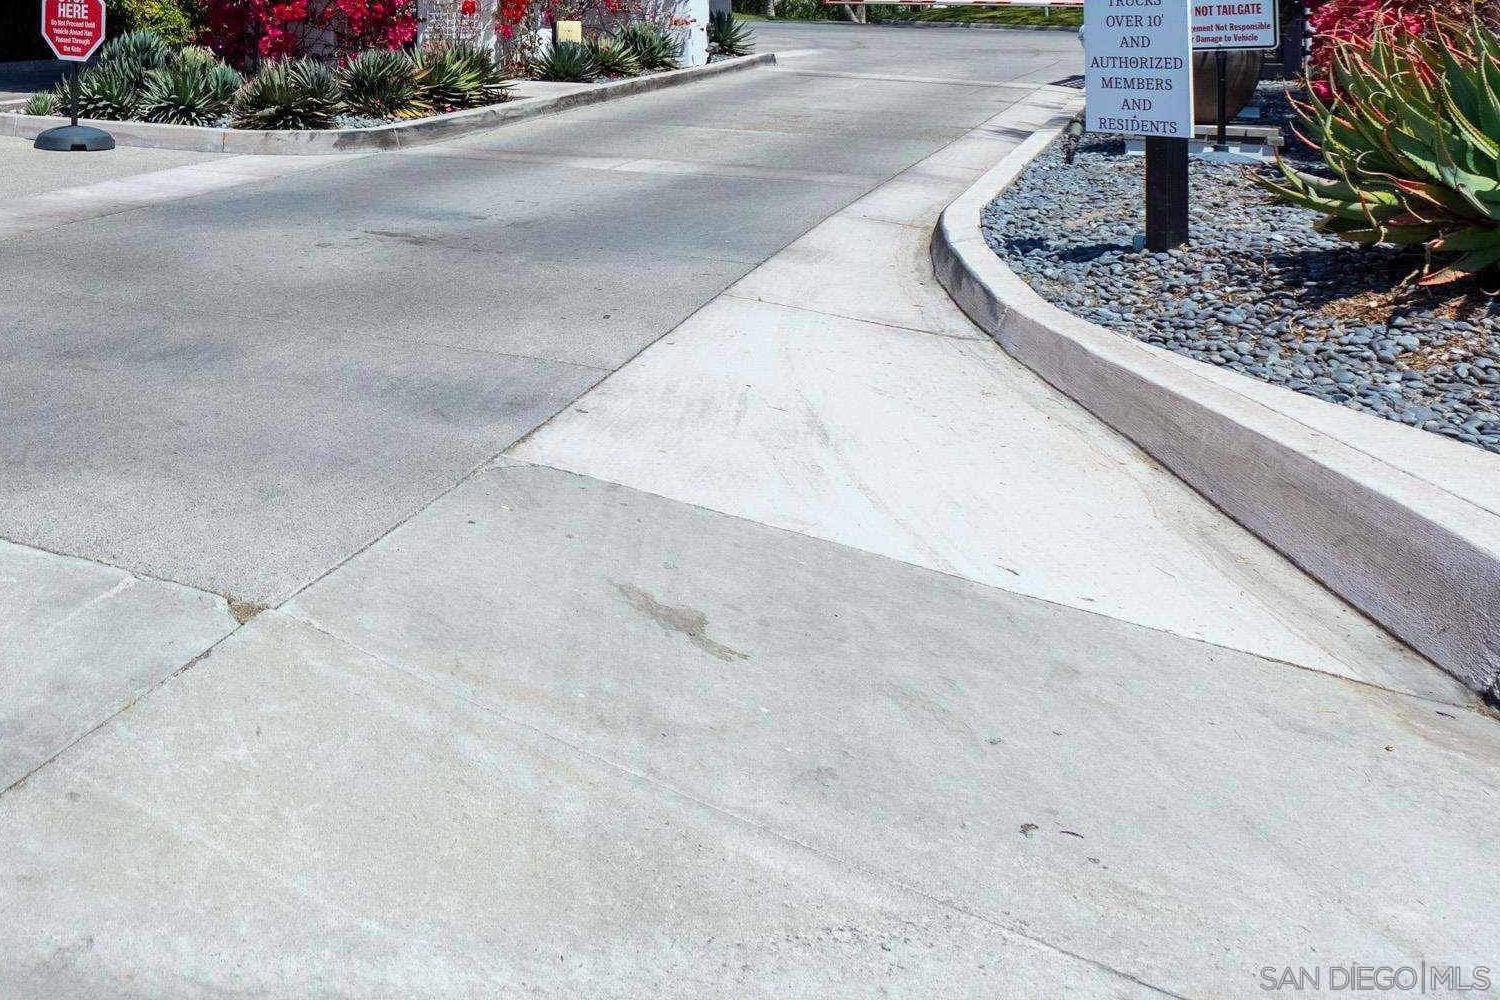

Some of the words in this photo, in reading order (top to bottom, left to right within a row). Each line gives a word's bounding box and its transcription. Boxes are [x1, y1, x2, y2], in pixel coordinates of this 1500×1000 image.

[58, 3, 89, 19] HERE
[1194, 5, 1215, 16] NOT
[1216, 3, 1262, 15] TAILGATE
[66, 20, 84, 28] Proceed
[1105, 15, 1143, 28] OVER
[1148, 14, 1164, 26] 10'
[1215, 23, 1228, 32] Not
[1229, 21, 1271, 31] Responsible
[1119, 36, 1151, 48] AND
[1196, 35, 1222, 44] Damage
[1233, 33, 1258, 42] Vehicle
[1090, 56, 1183, 69] AUTHORIZED
[1100, 77, 1173, 91] MEMBERS
[1121, 99, 1152, 111] AND
[1099, 117, 1177, 133] RESIDENTS
